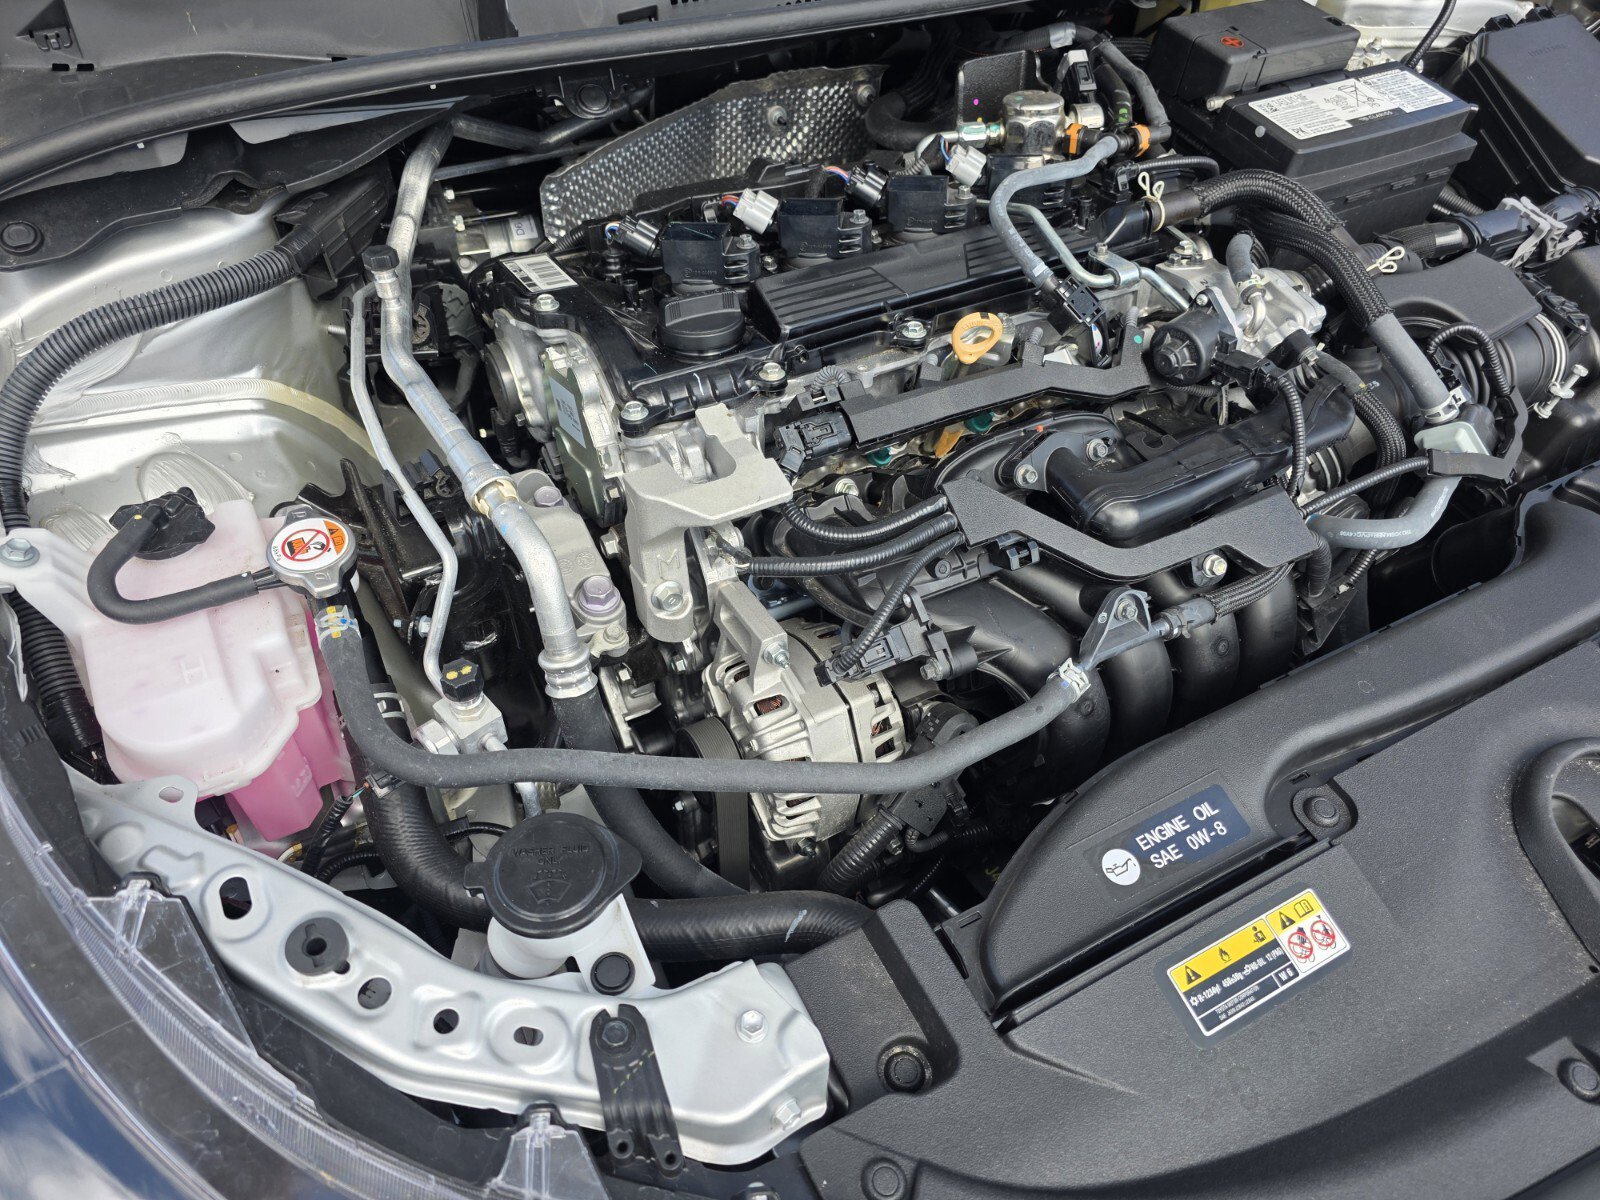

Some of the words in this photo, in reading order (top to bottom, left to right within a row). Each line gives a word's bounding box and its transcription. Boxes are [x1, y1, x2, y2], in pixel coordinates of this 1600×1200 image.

[1135, 815, 1190, 851] ENGINE
[1193, 801, 1220, 821] OIL
[512, 847, 554, 857] WASHER
[561, 844, 589, 854] FLUID
[1150, 844, 1183, 869] SAE
[1186, 821, 1227, 850] 0W-8
[537, 856, 562, 865] ONLY
